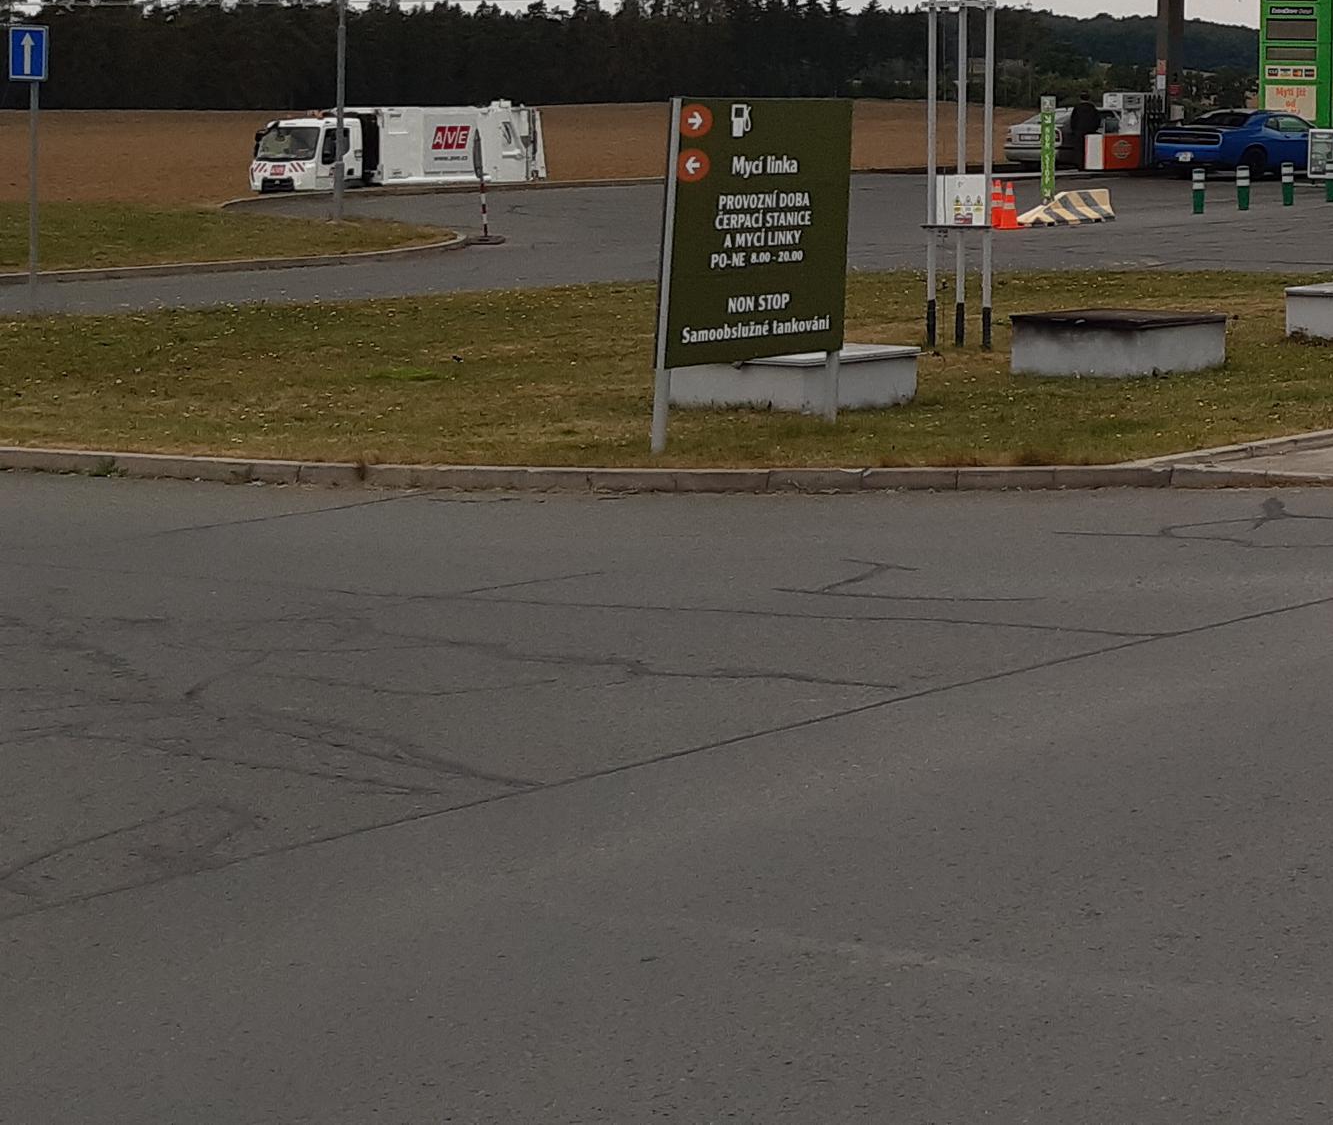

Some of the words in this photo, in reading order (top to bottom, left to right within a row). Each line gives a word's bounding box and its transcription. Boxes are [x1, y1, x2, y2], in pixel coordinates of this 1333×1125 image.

[433, 130, 468, 145] AVE
[731, 155, 763, 179] Mycí
[766, 154, 799, 174] linka
[718, 190, 778, 210] PROVOZNÍ
[779, 192, 810, 208] DOBA
[715, 209, 764, 230] ČERPACÍ
[765, 211, 812, 227] STANICE
[723, 234, 732, 248] A
[735, 228, 765, 247] MYCÍ
[767, 230, 802, 246] LINKY
[710, 252, 747, 269] PO-NE
[750, 252, 771, 264] 8.00
[777, 250, 803, 262] 20.00
[728, 296, 754, 313] NON
[757, 293, 791, 310] STOP
[682, 320, 769, 344] Samoobslužné
[772, 315, 831, 335] tankování
